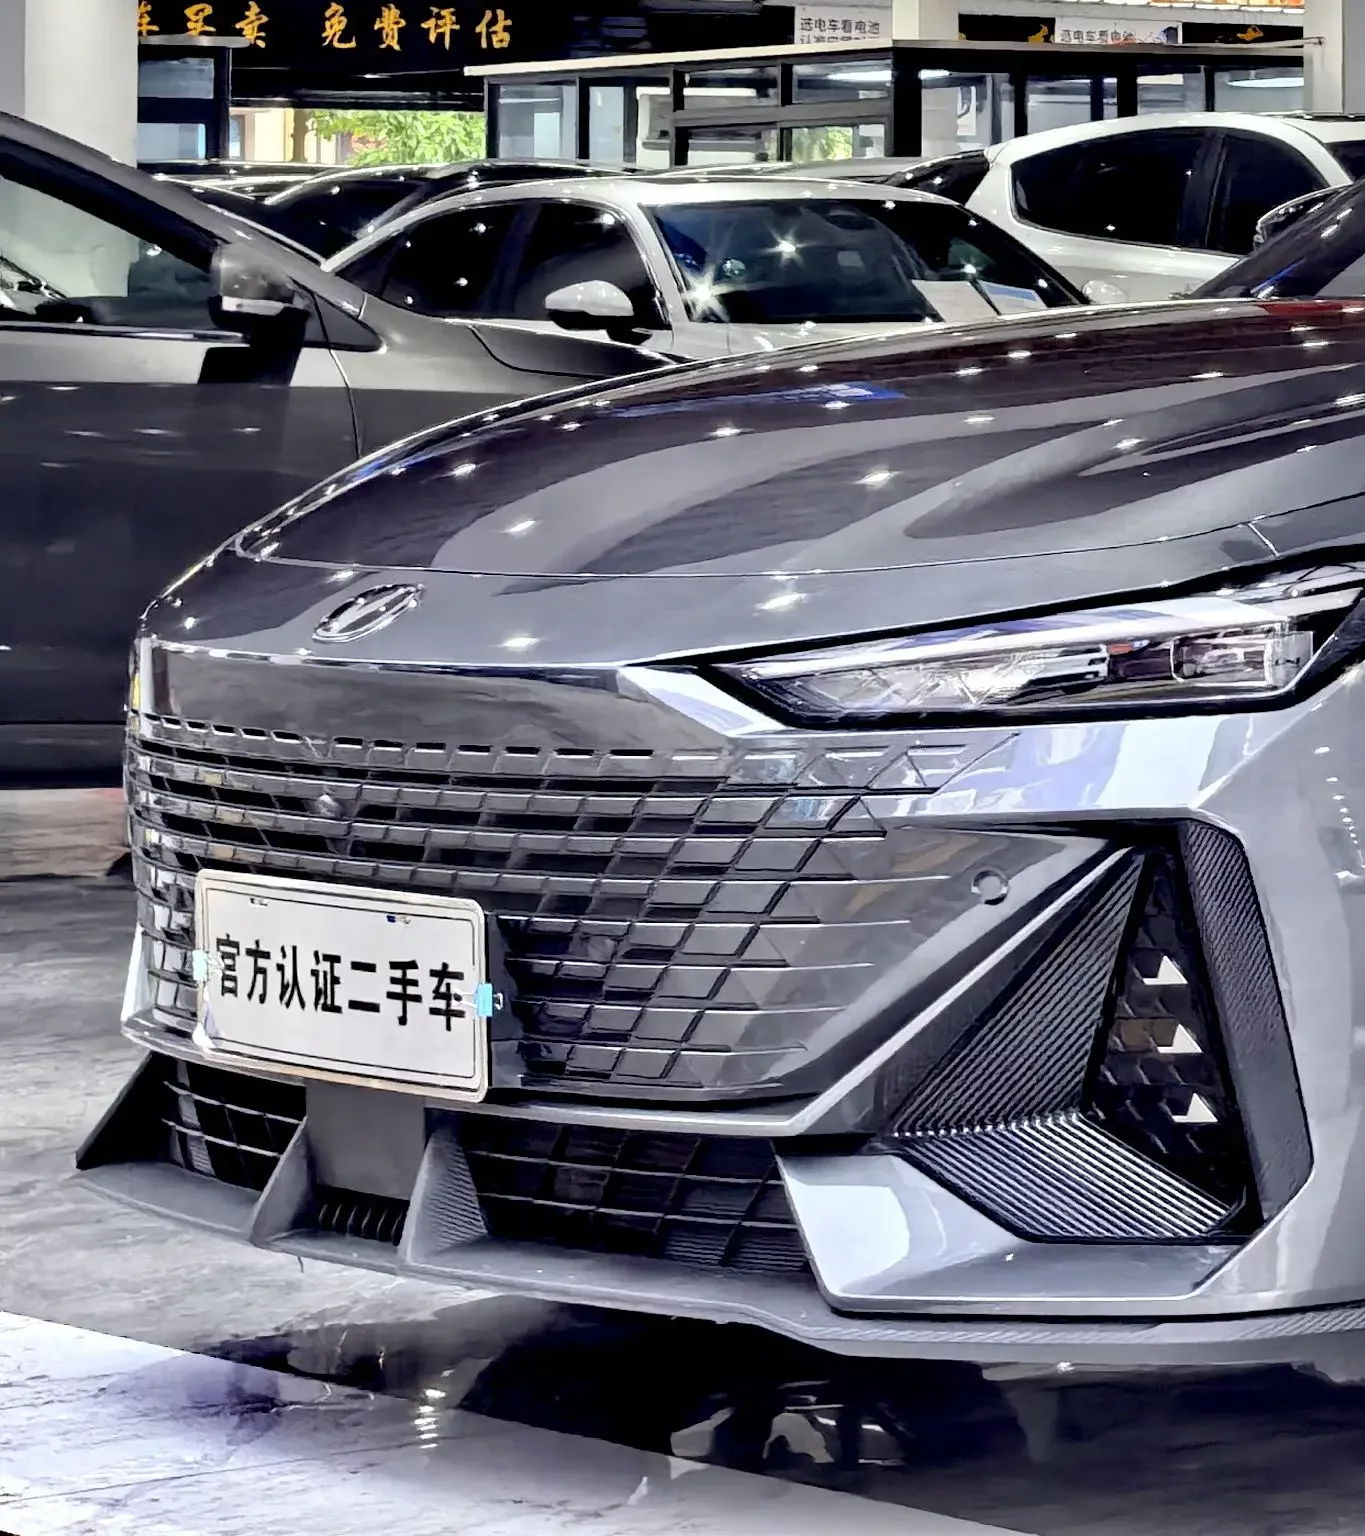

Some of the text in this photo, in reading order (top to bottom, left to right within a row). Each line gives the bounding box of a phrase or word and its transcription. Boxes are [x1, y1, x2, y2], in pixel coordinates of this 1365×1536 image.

[321, 2, 512, 51] 免费评估
[215, 934, 466, 1031] 官方认证二手车
